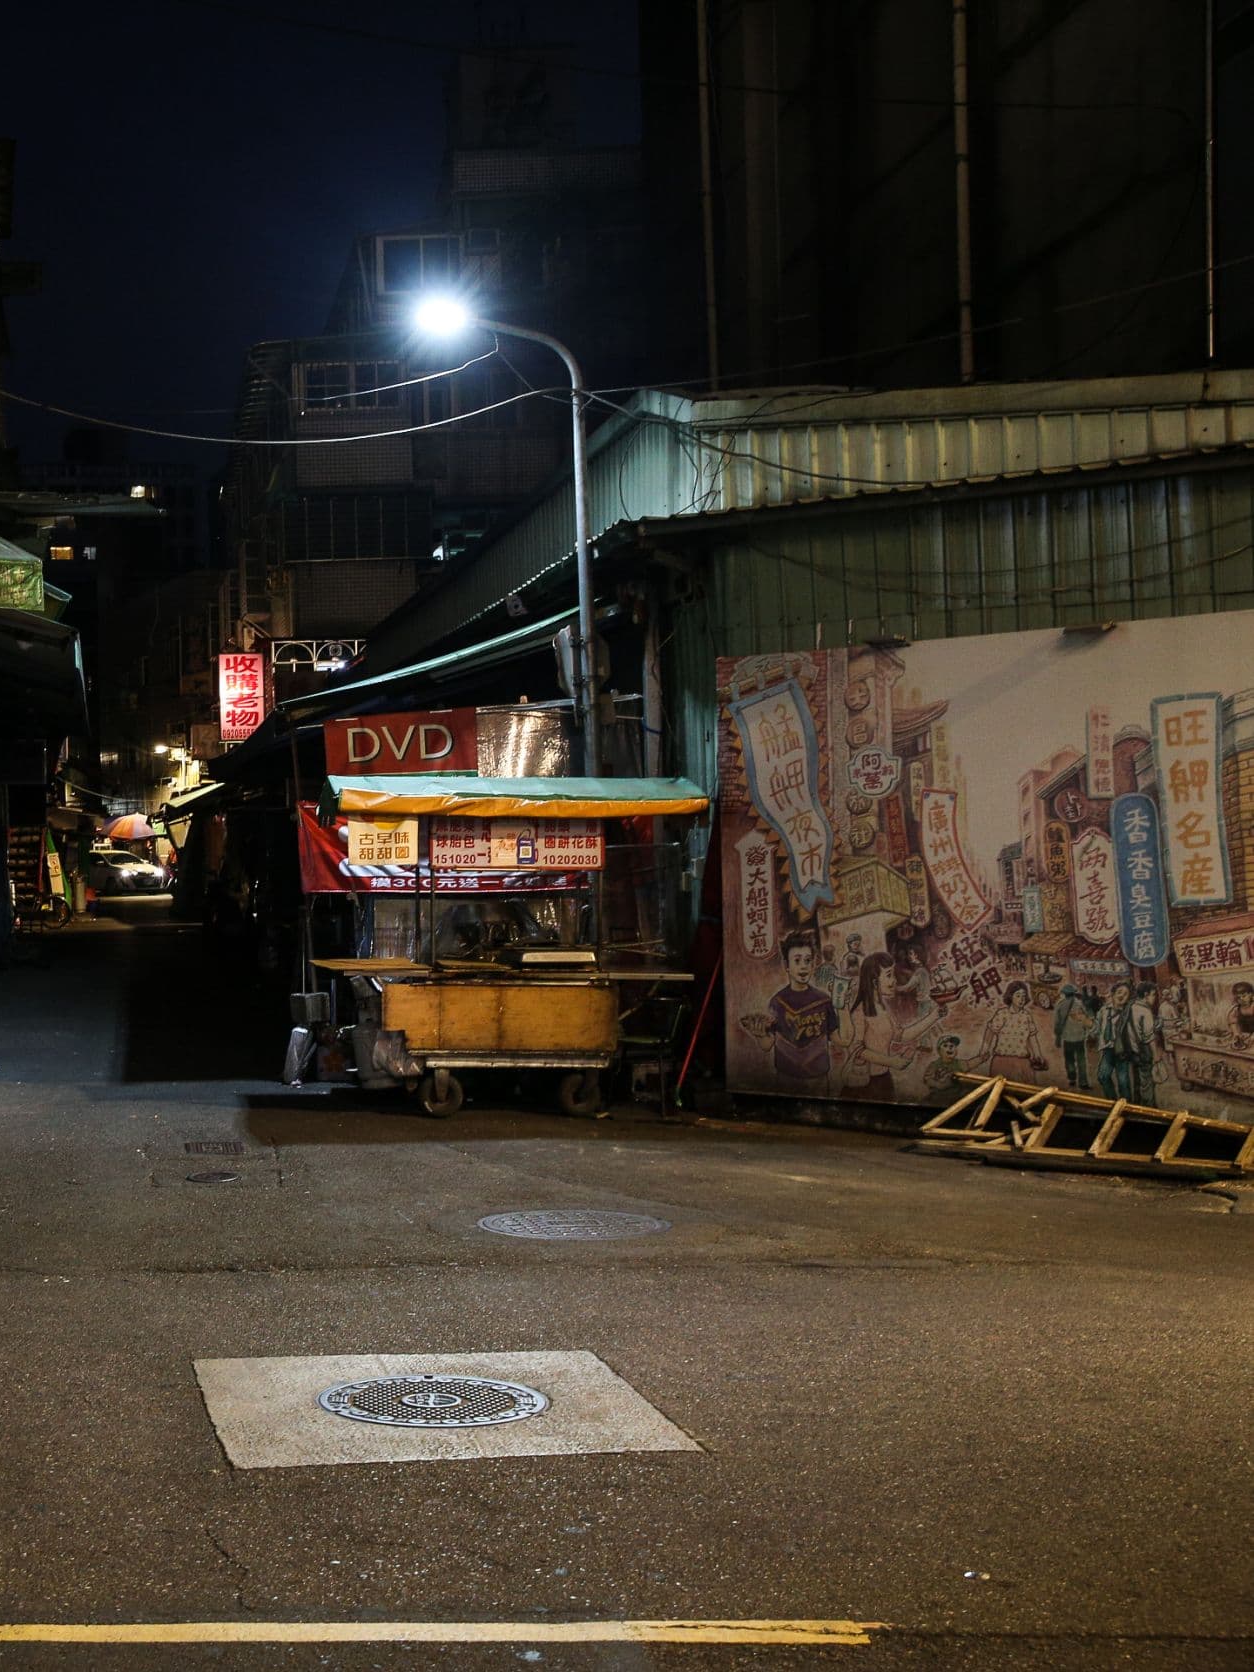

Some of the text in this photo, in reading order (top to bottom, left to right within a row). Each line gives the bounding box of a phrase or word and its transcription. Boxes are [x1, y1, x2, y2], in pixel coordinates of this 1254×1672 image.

[225, 656, 259, 726] 收購老物
[346, 724, 453, 763] DVD
[759, 703, 822, 876] 艋舺夜市
[1164, 710, 1215, 896] 旺舺名產
[359, 832, 410, 845] 古早味
[359, 847, 410, 859] 甜甜圈
[1123, 807, 1156, 961] 香香臭豆腐
[950, 936, 1003, 1004] 艋舺
